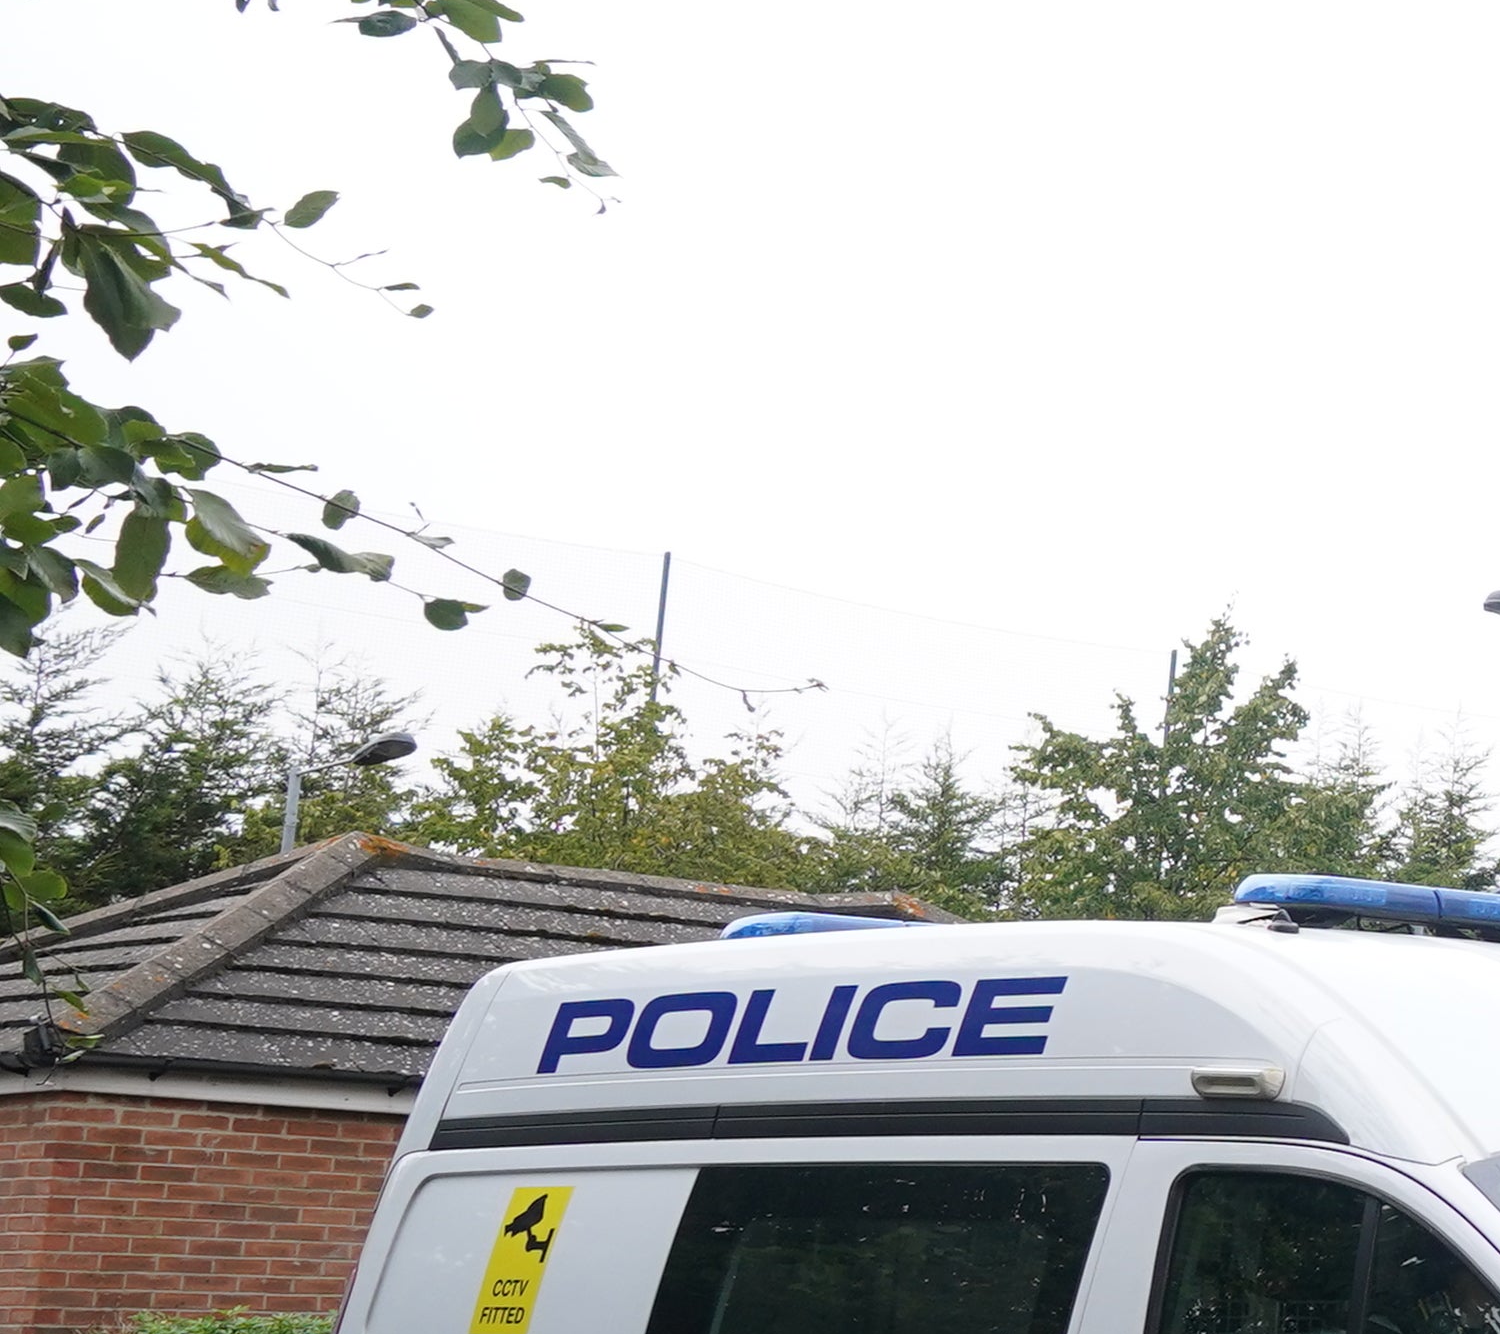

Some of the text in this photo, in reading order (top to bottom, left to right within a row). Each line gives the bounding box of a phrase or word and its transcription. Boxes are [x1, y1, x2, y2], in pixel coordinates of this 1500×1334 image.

[536, 976, 1068, 1074] POLICE
[492, 1279, 529, 1297] CCTV
[479, 1307, 525, 1324] FITTED
